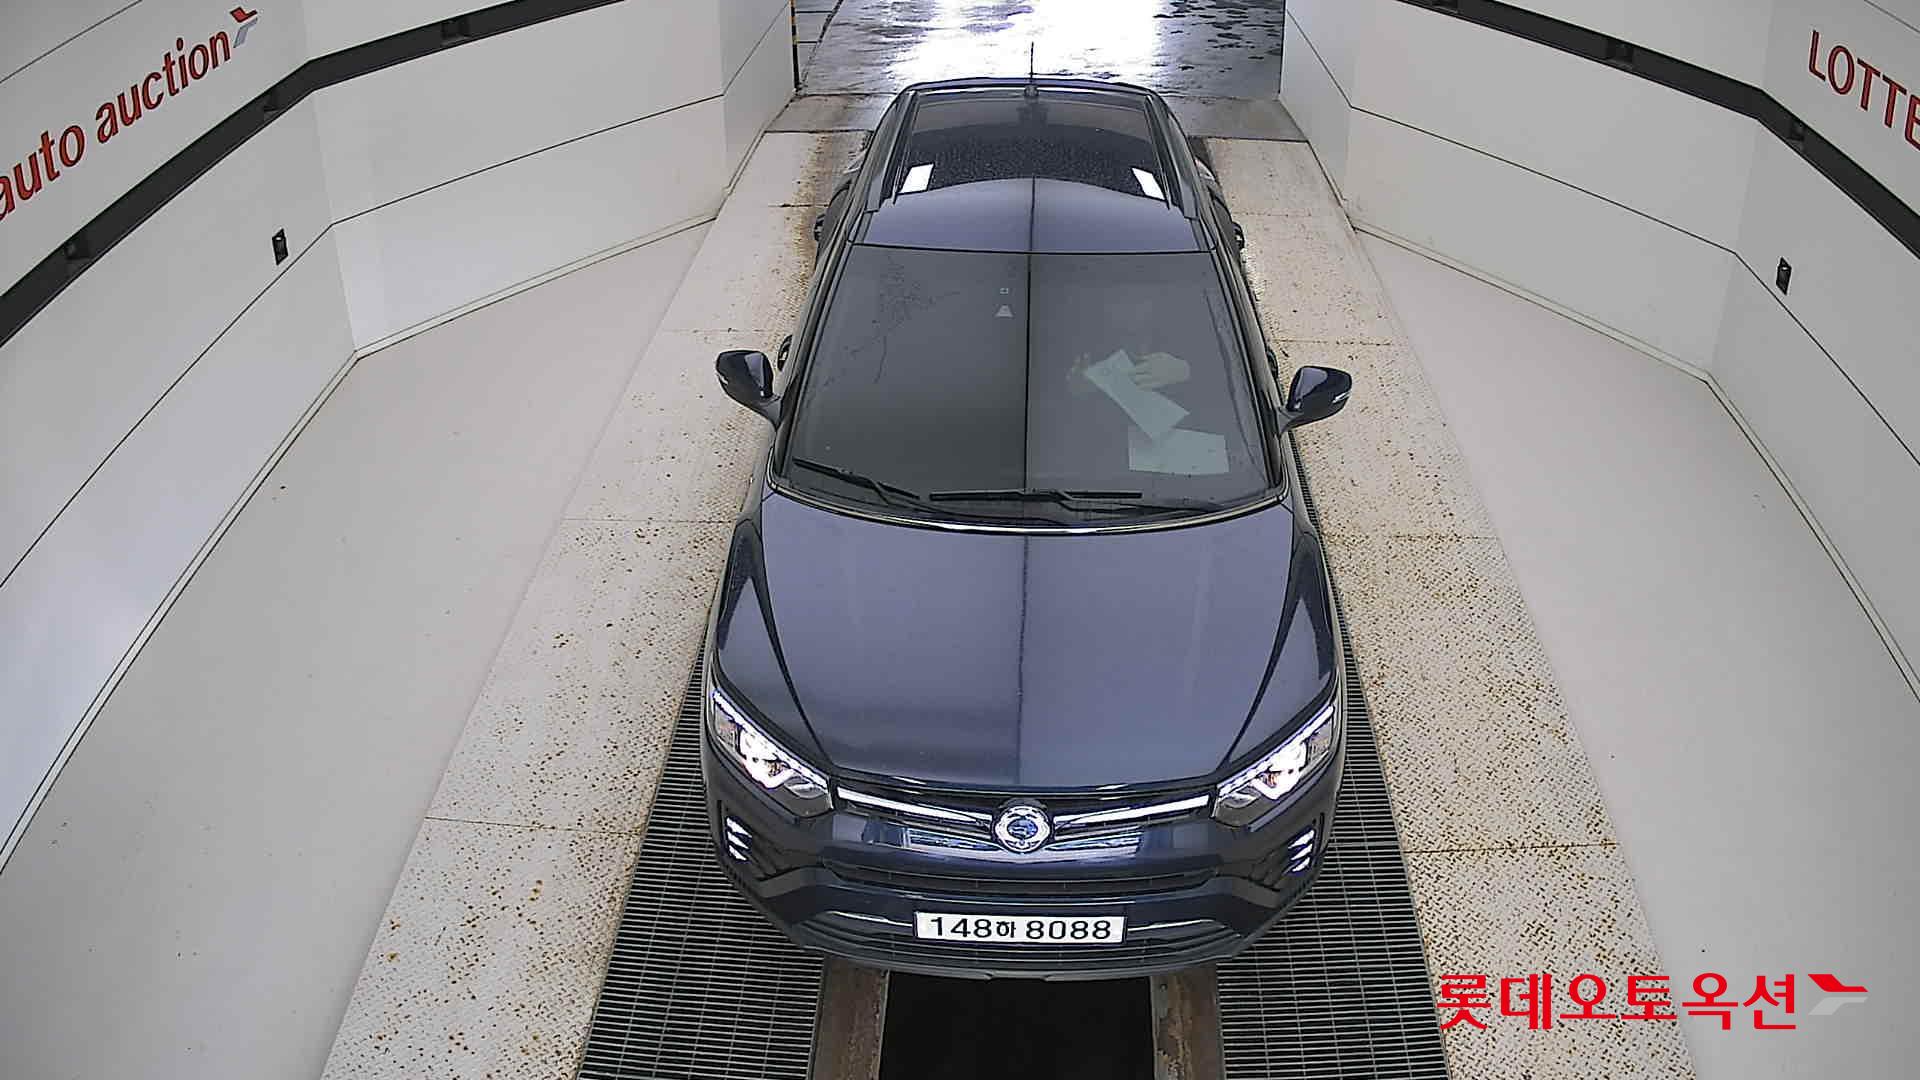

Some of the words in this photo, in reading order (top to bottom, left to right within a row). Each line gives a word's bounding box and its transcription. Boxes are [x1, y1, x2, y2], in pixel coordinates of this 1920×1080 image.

[0, 125, 86, 221] auto
[95, 30, 232, 144] auction
[1808, 29, 1920, 152] LOTTE
[930, 916, 1017, 938] 148하
[1026, 920, 1112, 940] 8088
